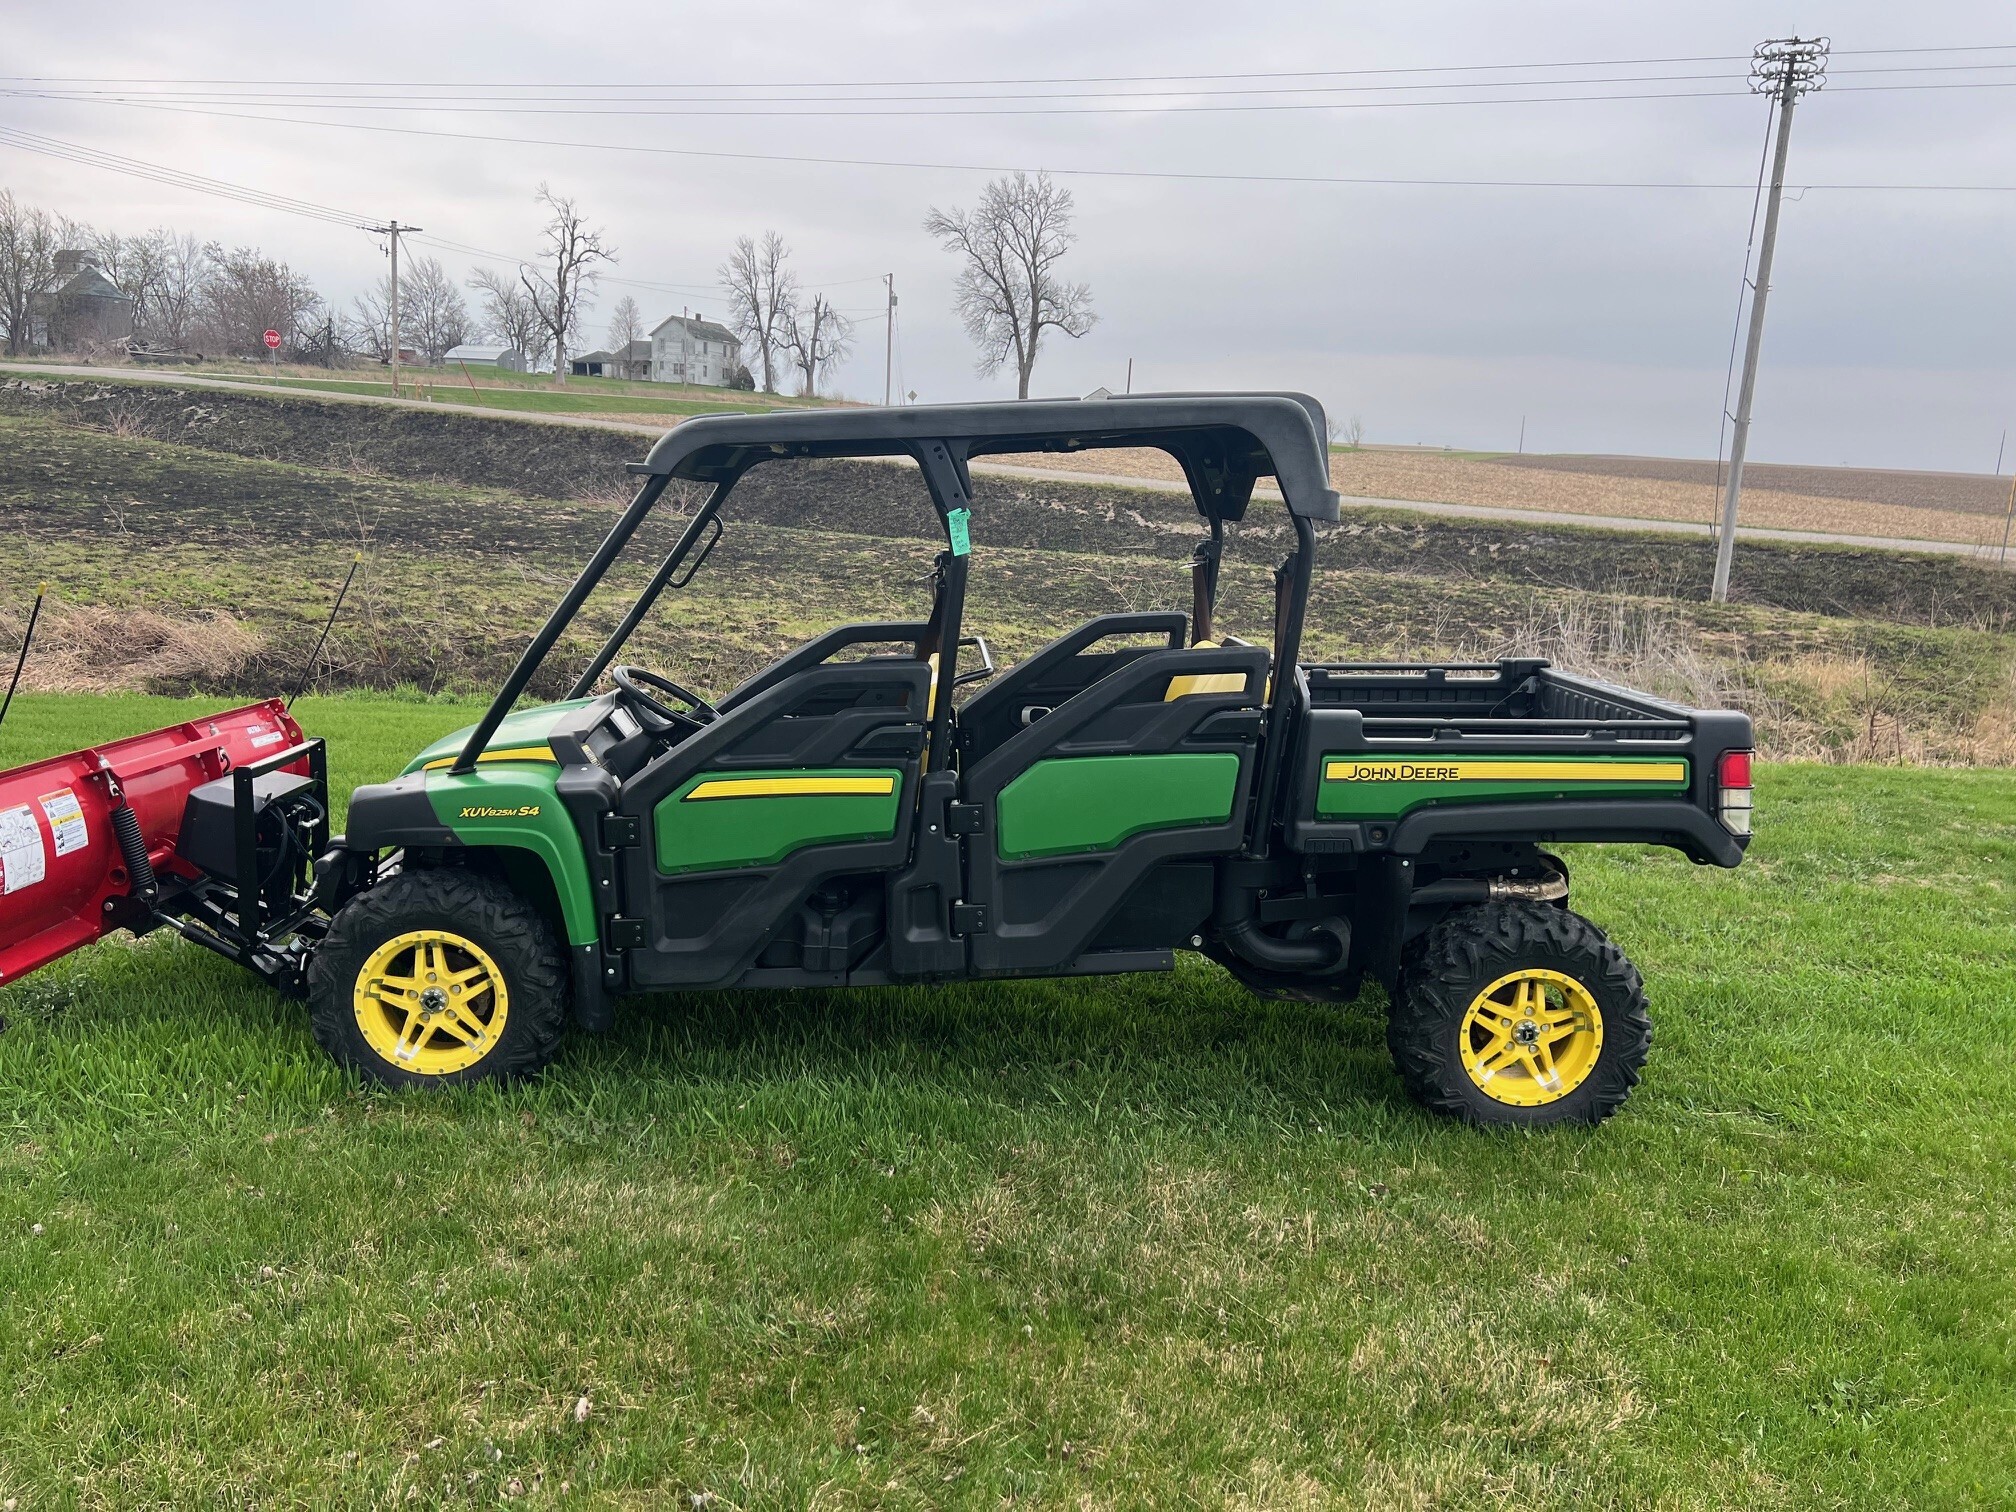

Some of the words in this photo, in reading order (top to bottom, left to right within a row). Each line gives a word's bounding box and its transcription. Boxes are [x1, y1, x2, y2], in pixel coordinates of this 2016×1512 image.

[265, 335, 280, 343] STOP
[1347, 765, 1396, 779] JOHN
[1400, 765, 1459, 779] DEERE
[459, 807, 517, 818] XUV825M
[518, 806, 540, 817] S4
